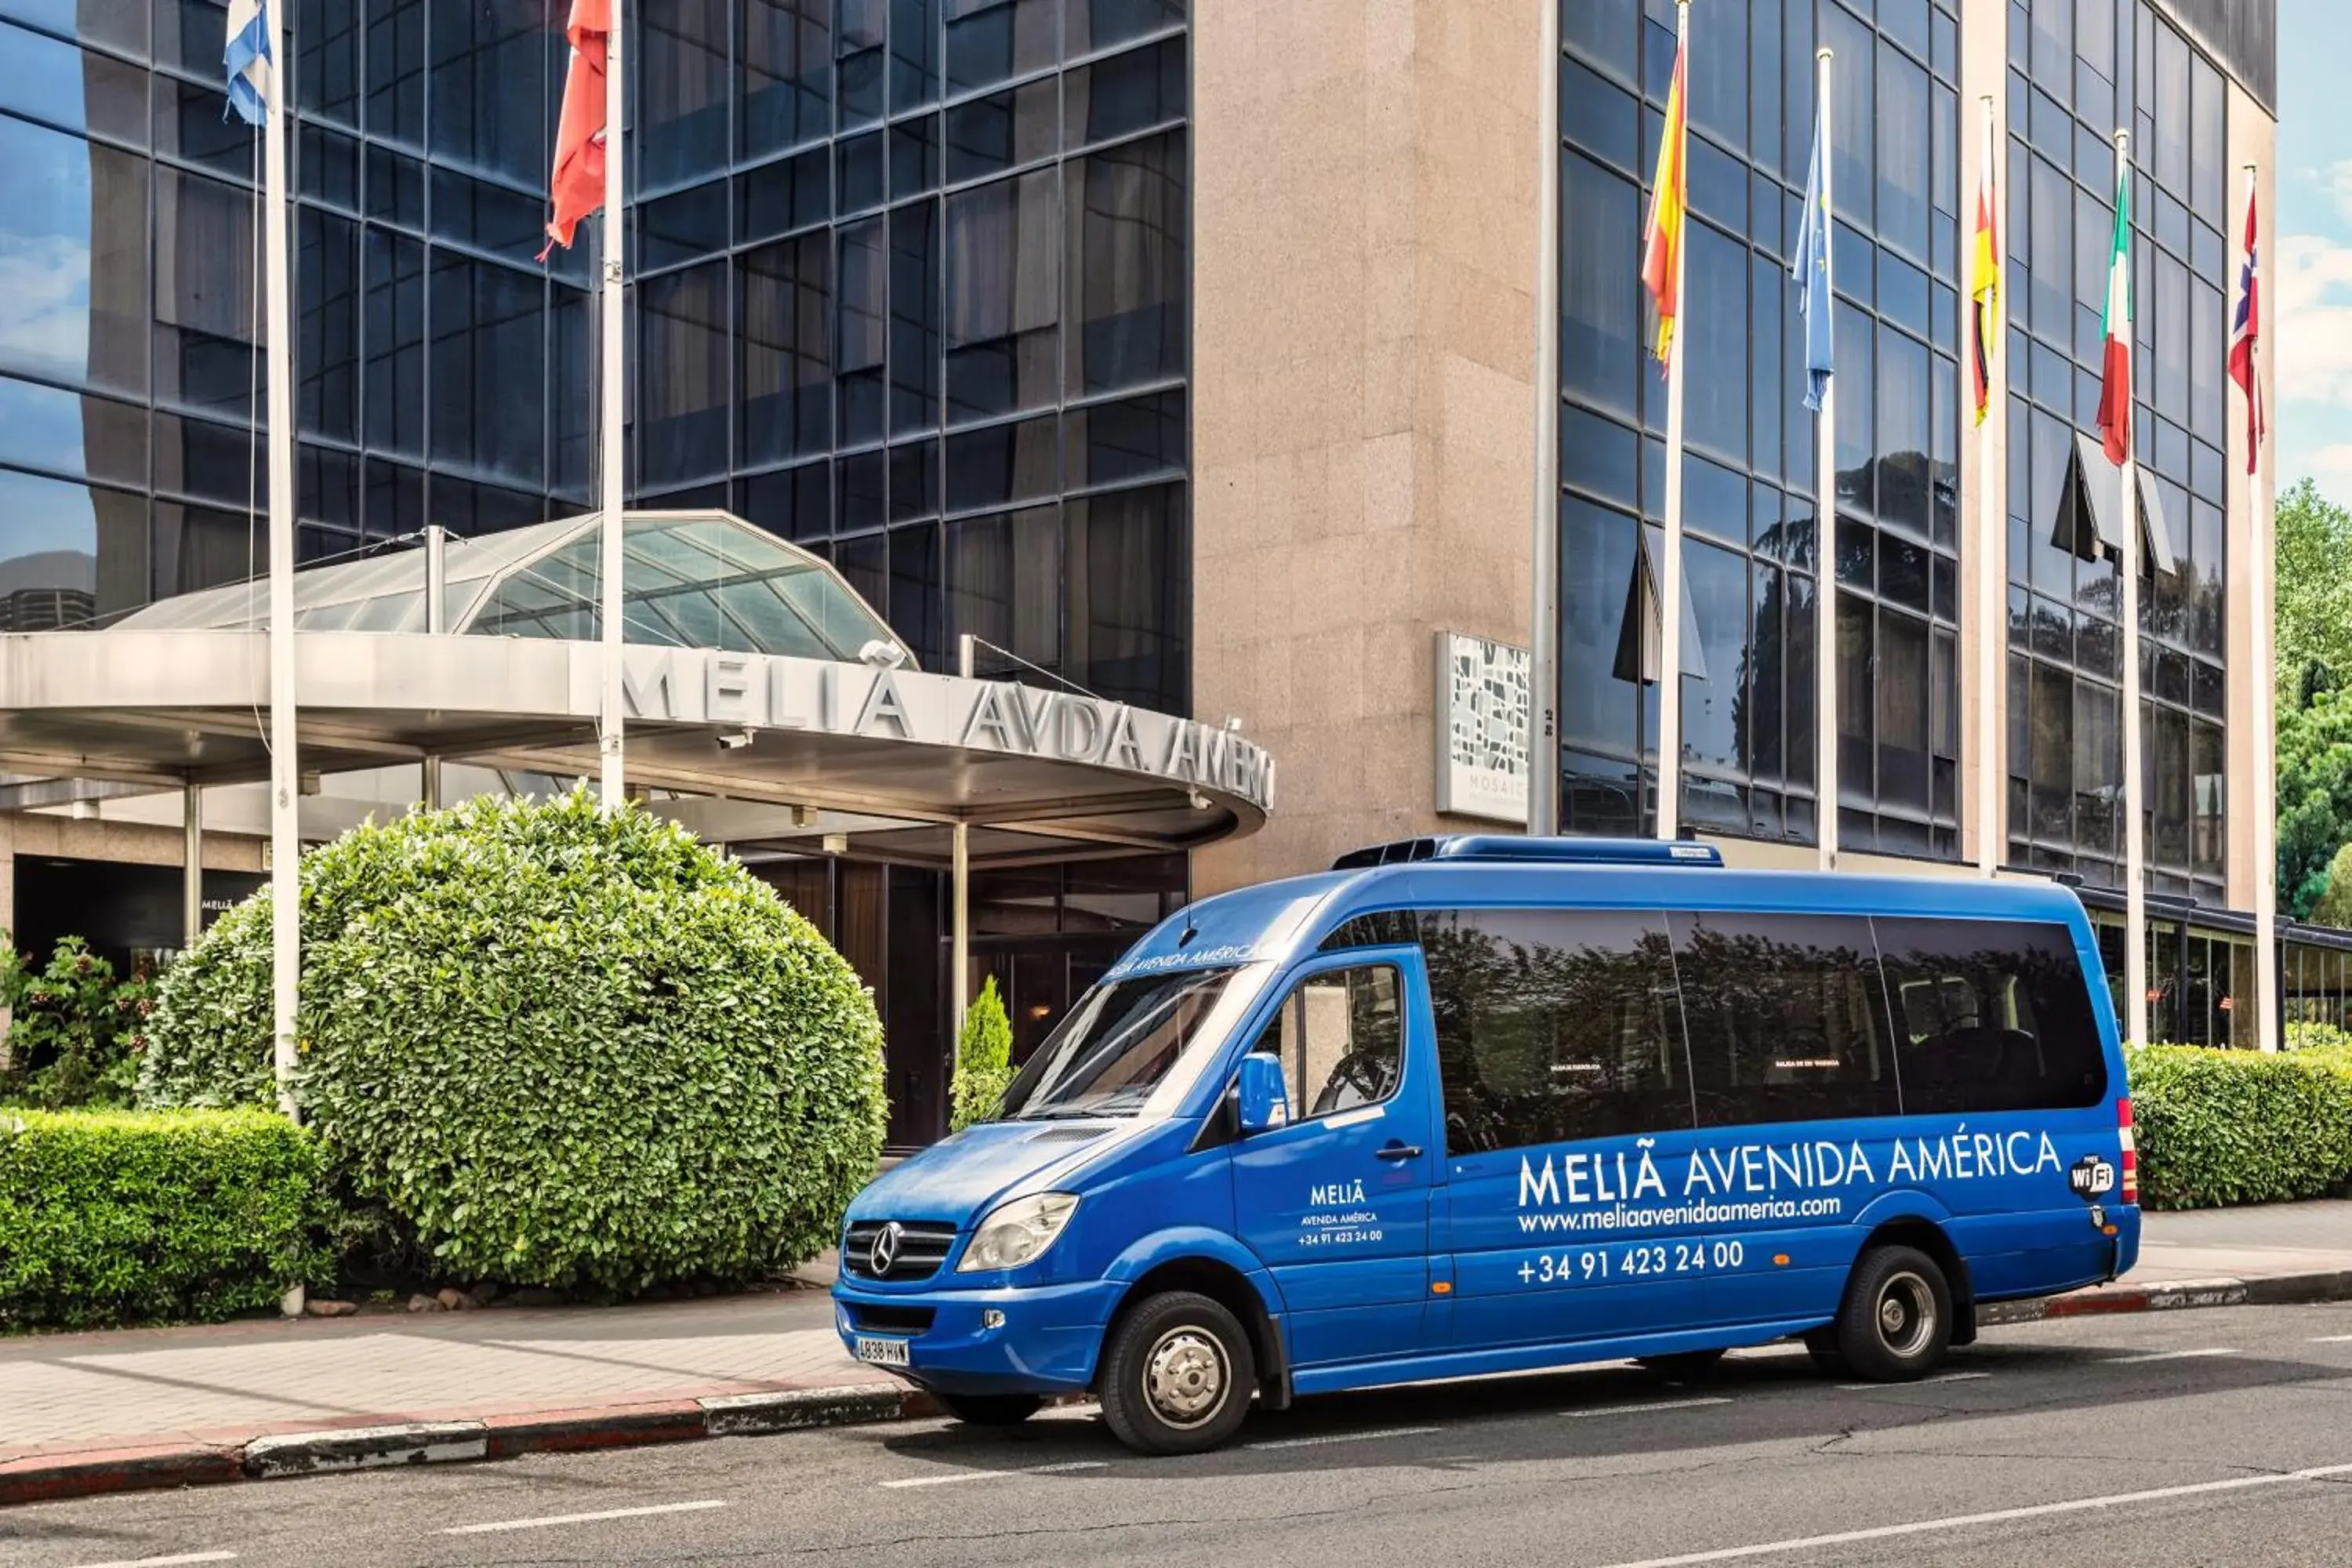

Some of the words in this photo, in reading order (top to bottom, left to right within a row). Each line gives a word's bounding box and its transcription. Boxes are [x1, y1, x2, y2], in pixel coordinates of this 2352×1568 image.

[1683, 1138, 1875, 1196] AVENIDA
[1887, 1122, 2062, 1184] AMÉRICA
[1301, 1214, 1338, 1226] AVENIDA
[1518, 1194, 1841, 1233] www.meliaavenidaamerica.com
[1298, 1235, 1319, 1246] +34
[1321, 1233, 1331, 1243] 91
[1335, 1232, 1353, 1243] 423
[1355, 1231, 1367, 1241] 24
[1370, 1230, 1382, 1241] 00
[1517, 1255, 1571, 1284] +34
[1581, 1251, 1608, 1279] 91
[1621, 1249, 1668, 1276] 423
[1675, 1244, 1704, 1271] 24
[1714, 1241, 1744, 1268] 00
